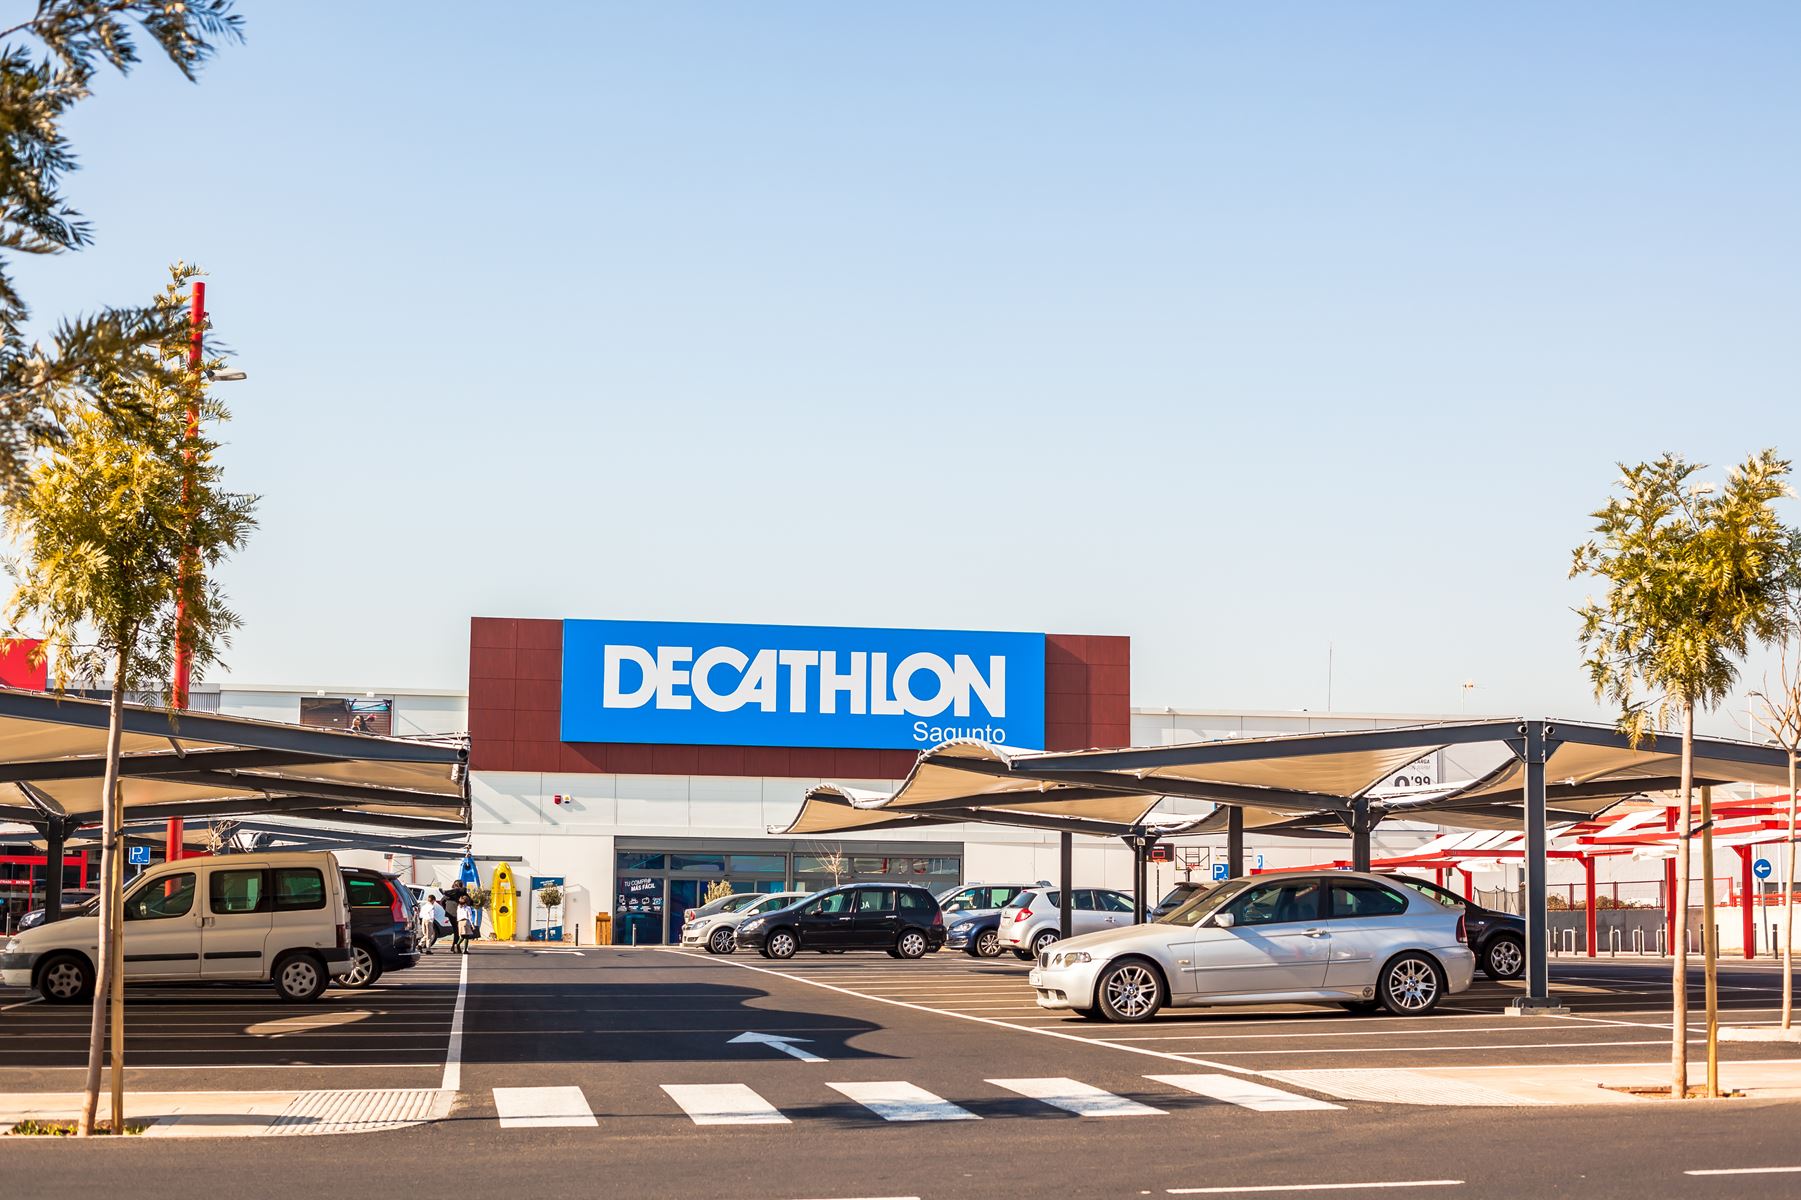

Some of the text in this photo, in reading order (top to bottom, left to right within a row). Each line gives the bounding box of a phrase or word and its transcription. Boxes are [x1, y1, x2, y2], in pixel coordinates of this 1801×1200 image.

[603, 644, 1006, 718] DECATHLON
[913, 721, 1006, 743] Sagunto
[131, 846, 144, 860] P
[1214, 865, 1224, 878] P
